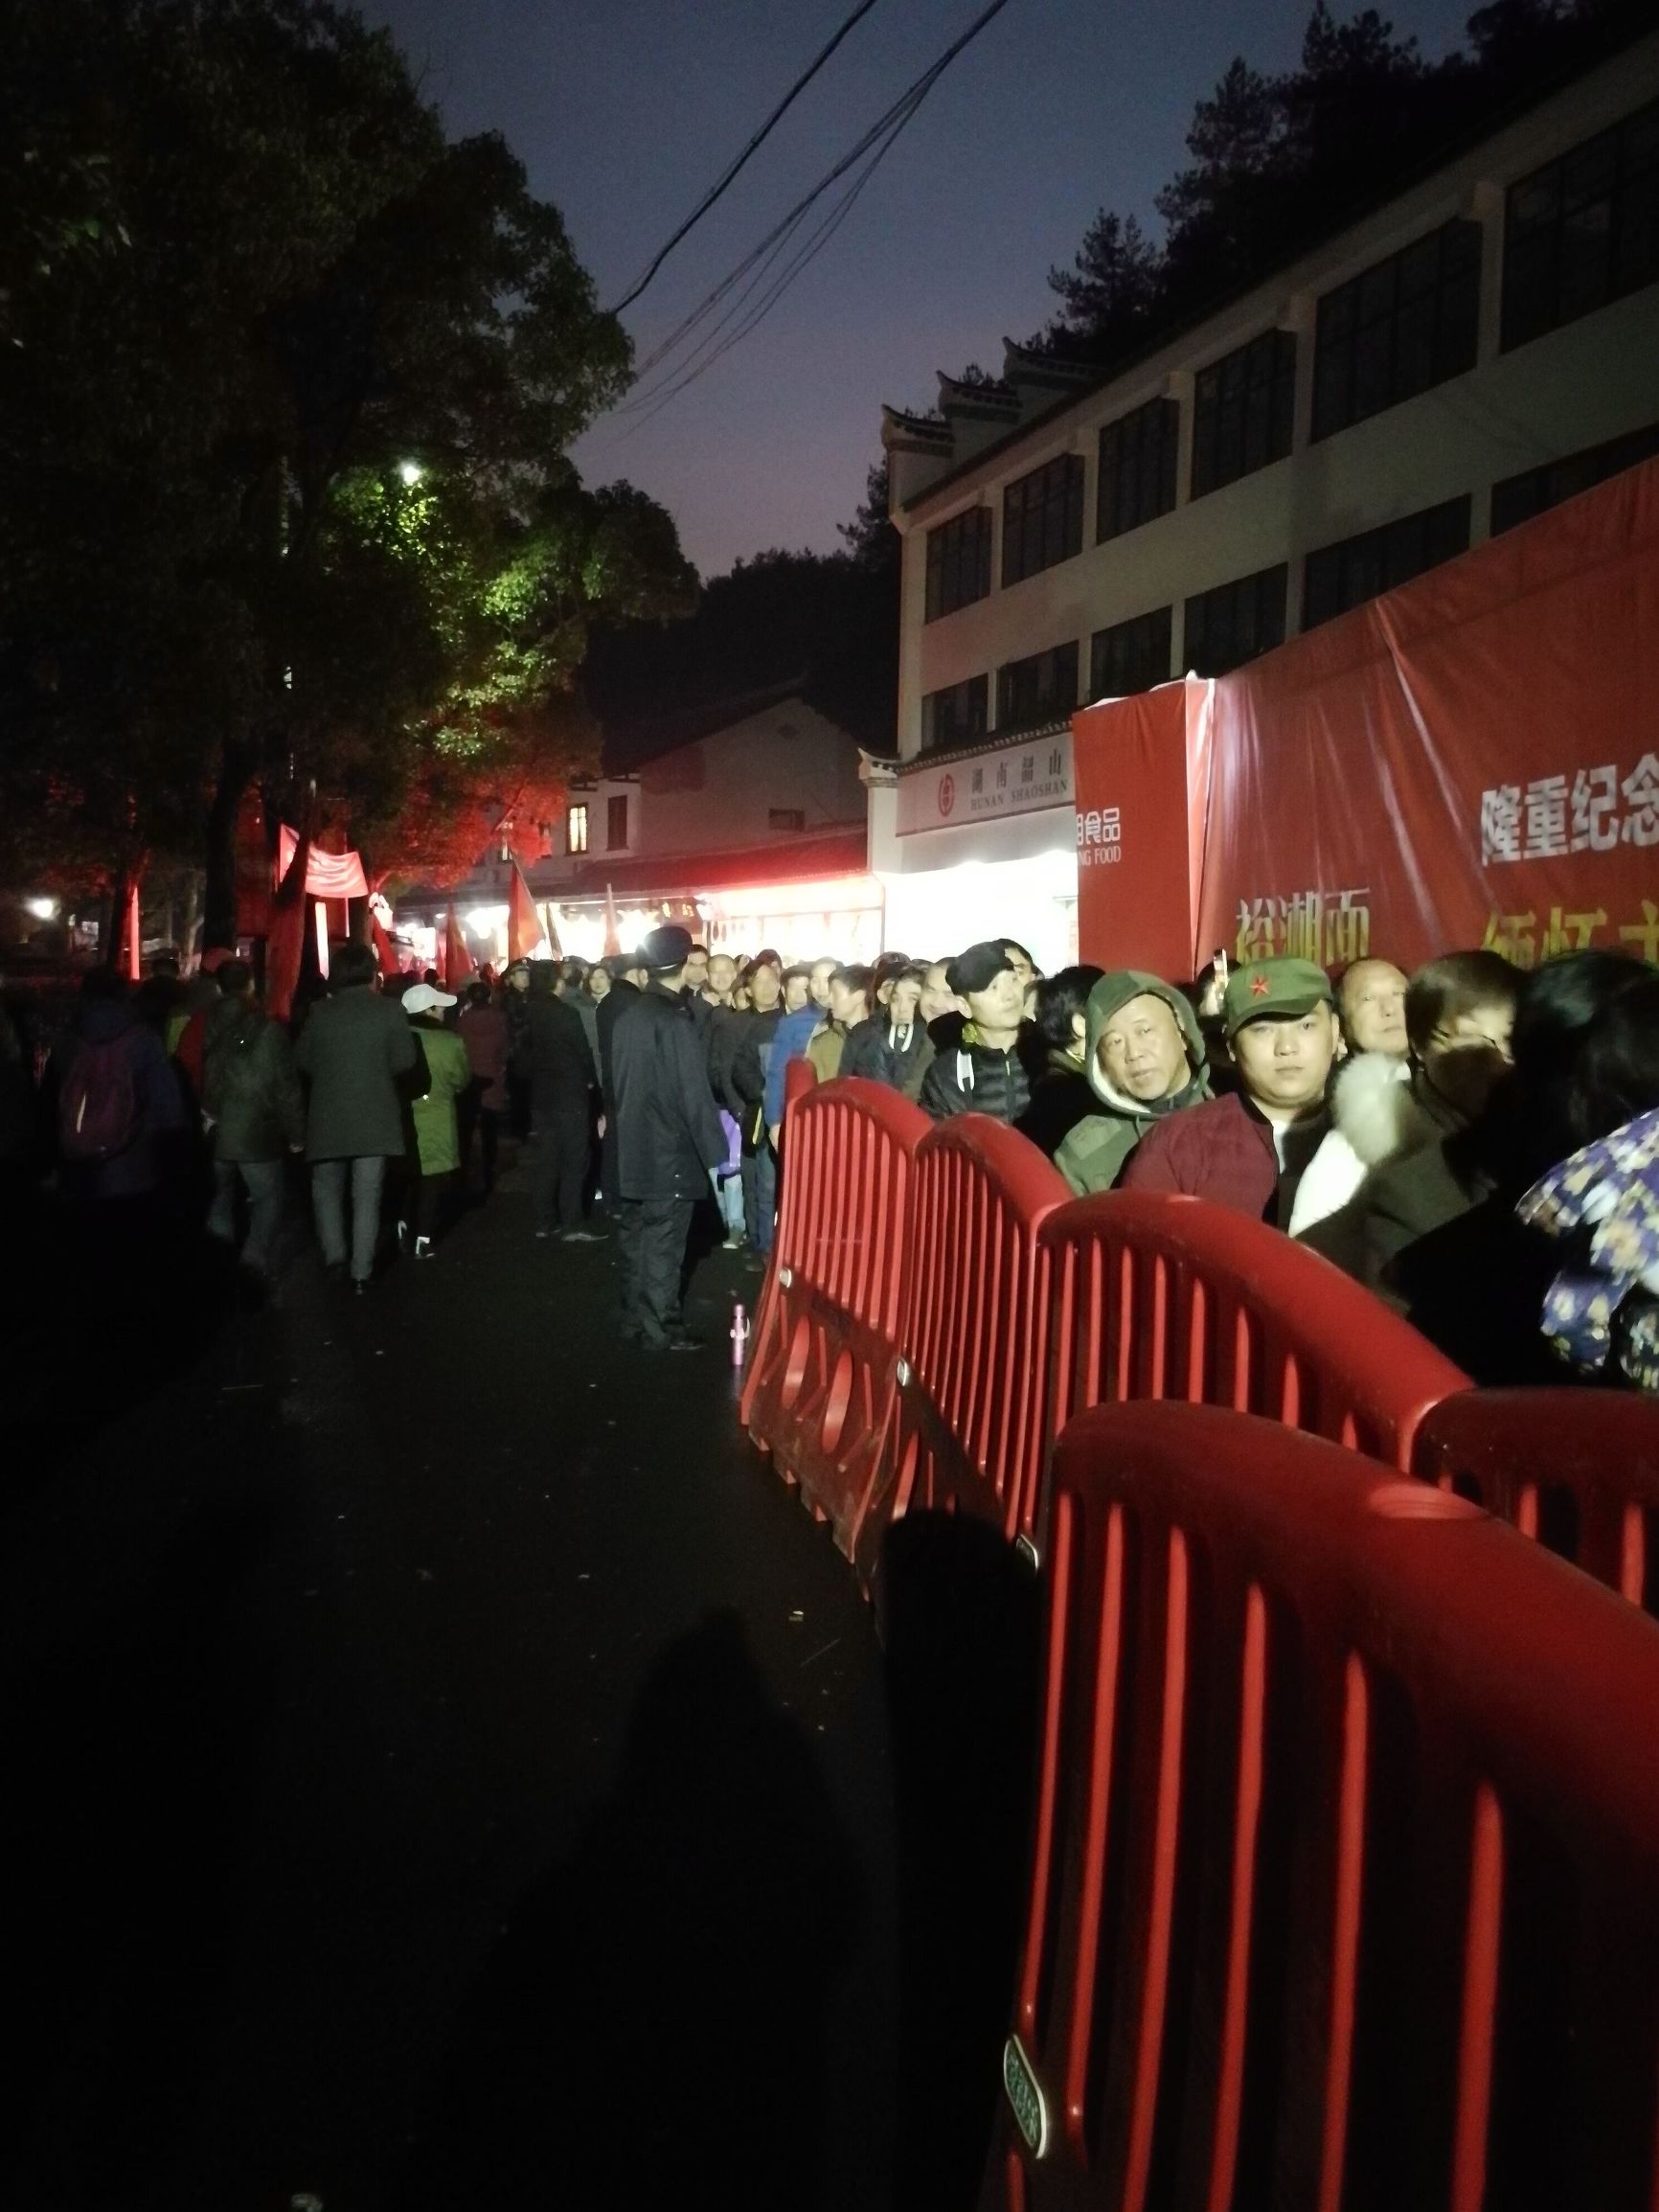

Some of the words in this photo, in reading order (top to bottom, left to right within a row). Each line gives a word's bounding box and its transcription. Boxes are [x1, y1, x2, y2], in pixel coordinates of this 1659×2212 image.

[970, 793, 1005, 811] HUNAN
[1011, 779, 1067, 803] SHAOSHAN
[1481, 752, 1659, 867] 隆重纪念
[1095, 845, 1122, 865] FOOD
